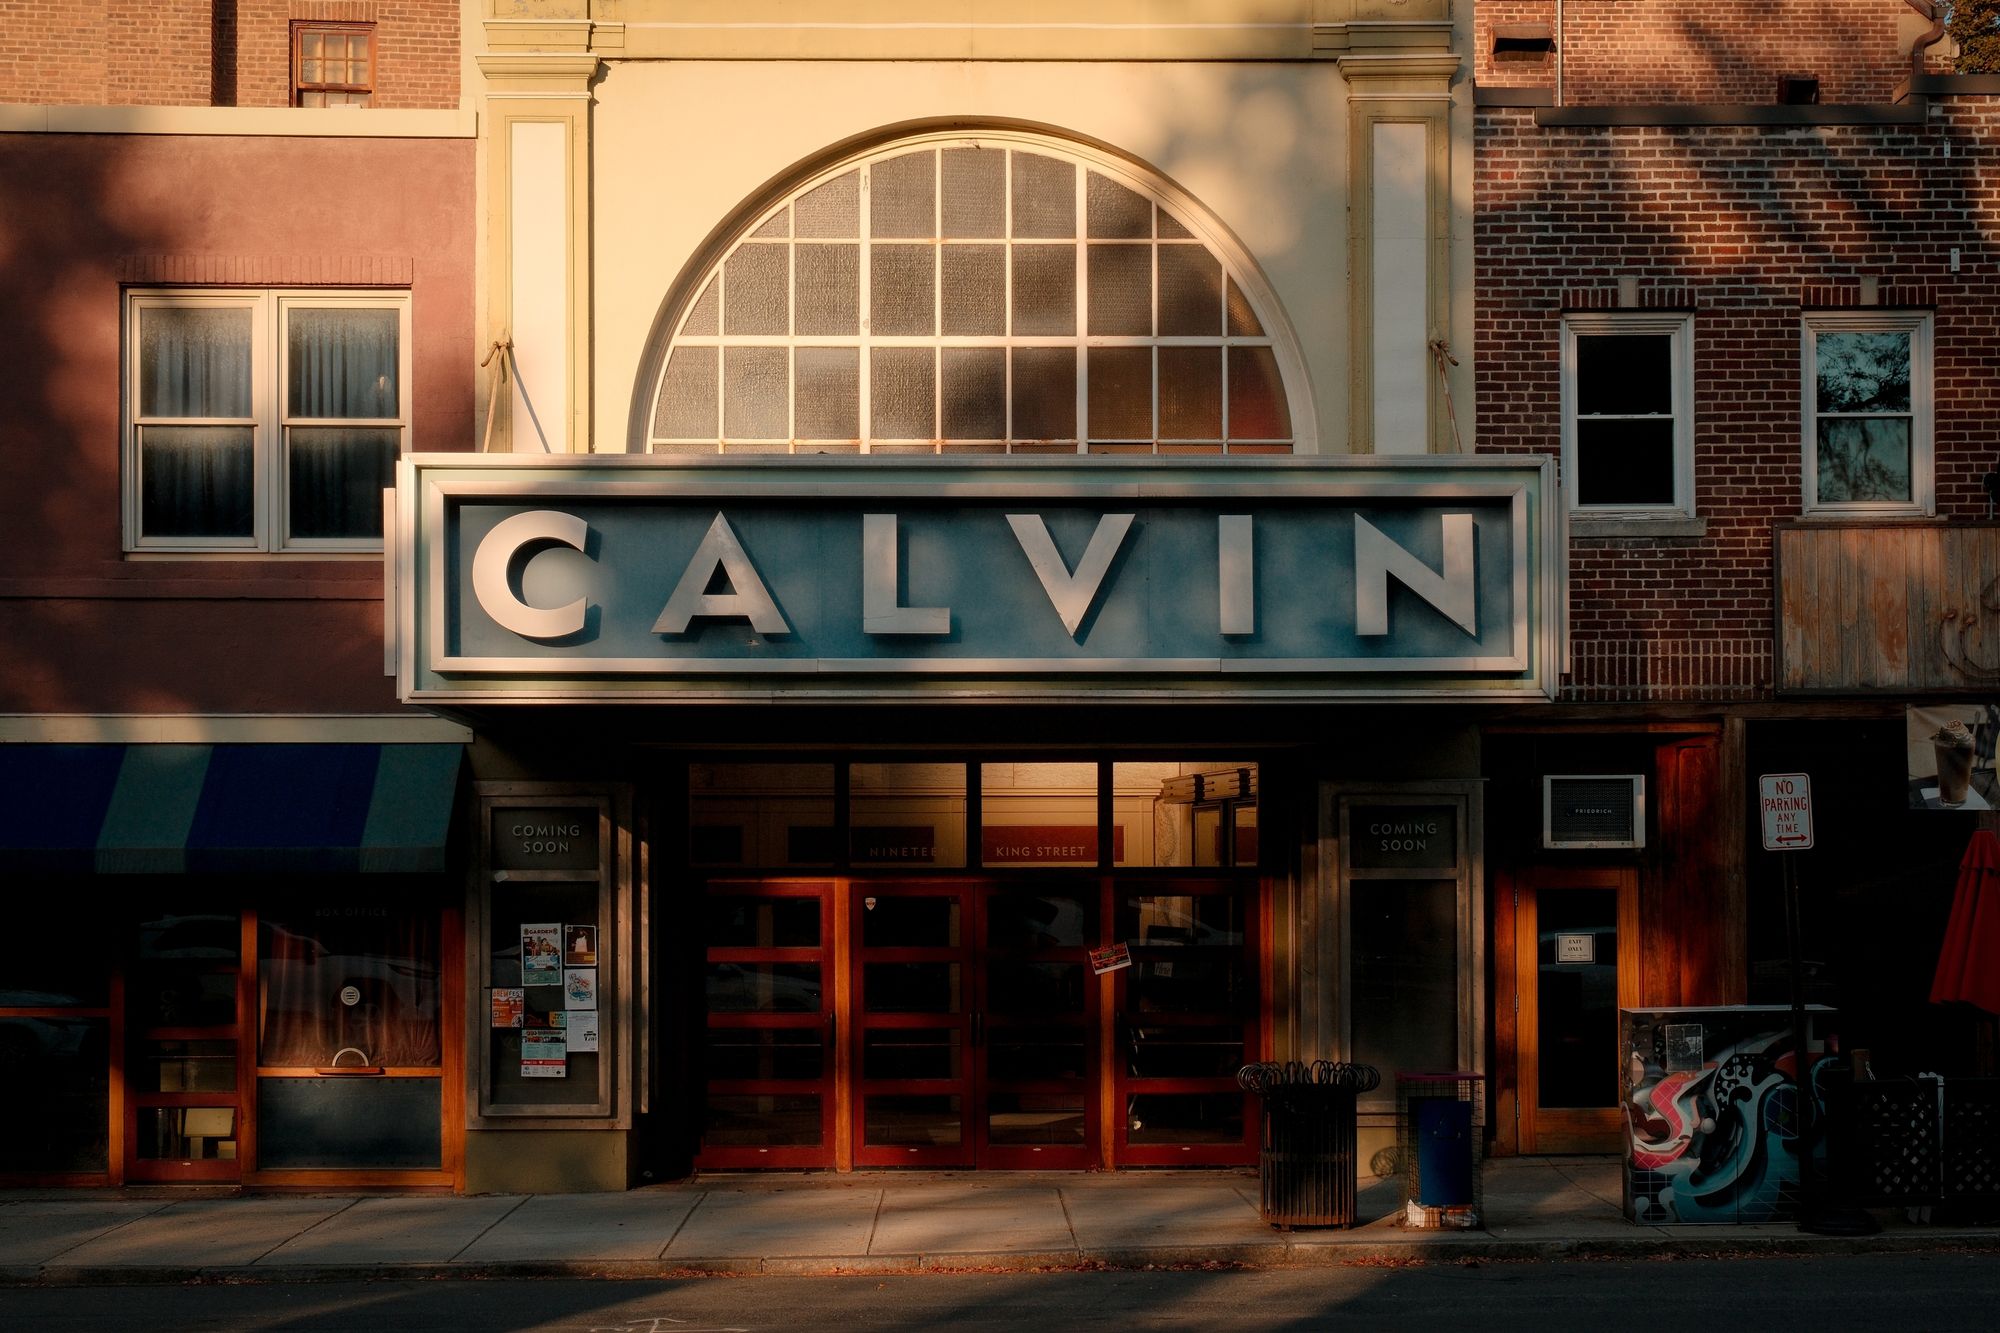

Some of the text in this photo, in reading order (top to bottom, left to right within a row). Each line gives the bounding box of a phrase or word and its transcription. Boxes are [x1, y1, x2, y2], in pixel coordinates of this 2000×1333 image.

[472, 509, 1478, 646] CALVIN
[1775, 780, 1794, 795] NO
[1764, 796, 1807, 811] PARKING
[1777, 812, 1796, 822] ANY
[511, 824, 581, 837] COMING
[1369, 823, 1438, 836] COMING
[1776, 823, 1799, 833] TIME
[523, 841, 570, 853] SOON
[996, 846, 1031, 857] KING
[1036, 846, 1086, 857] STREET
[1380, 839, 1427, 852] SOON
